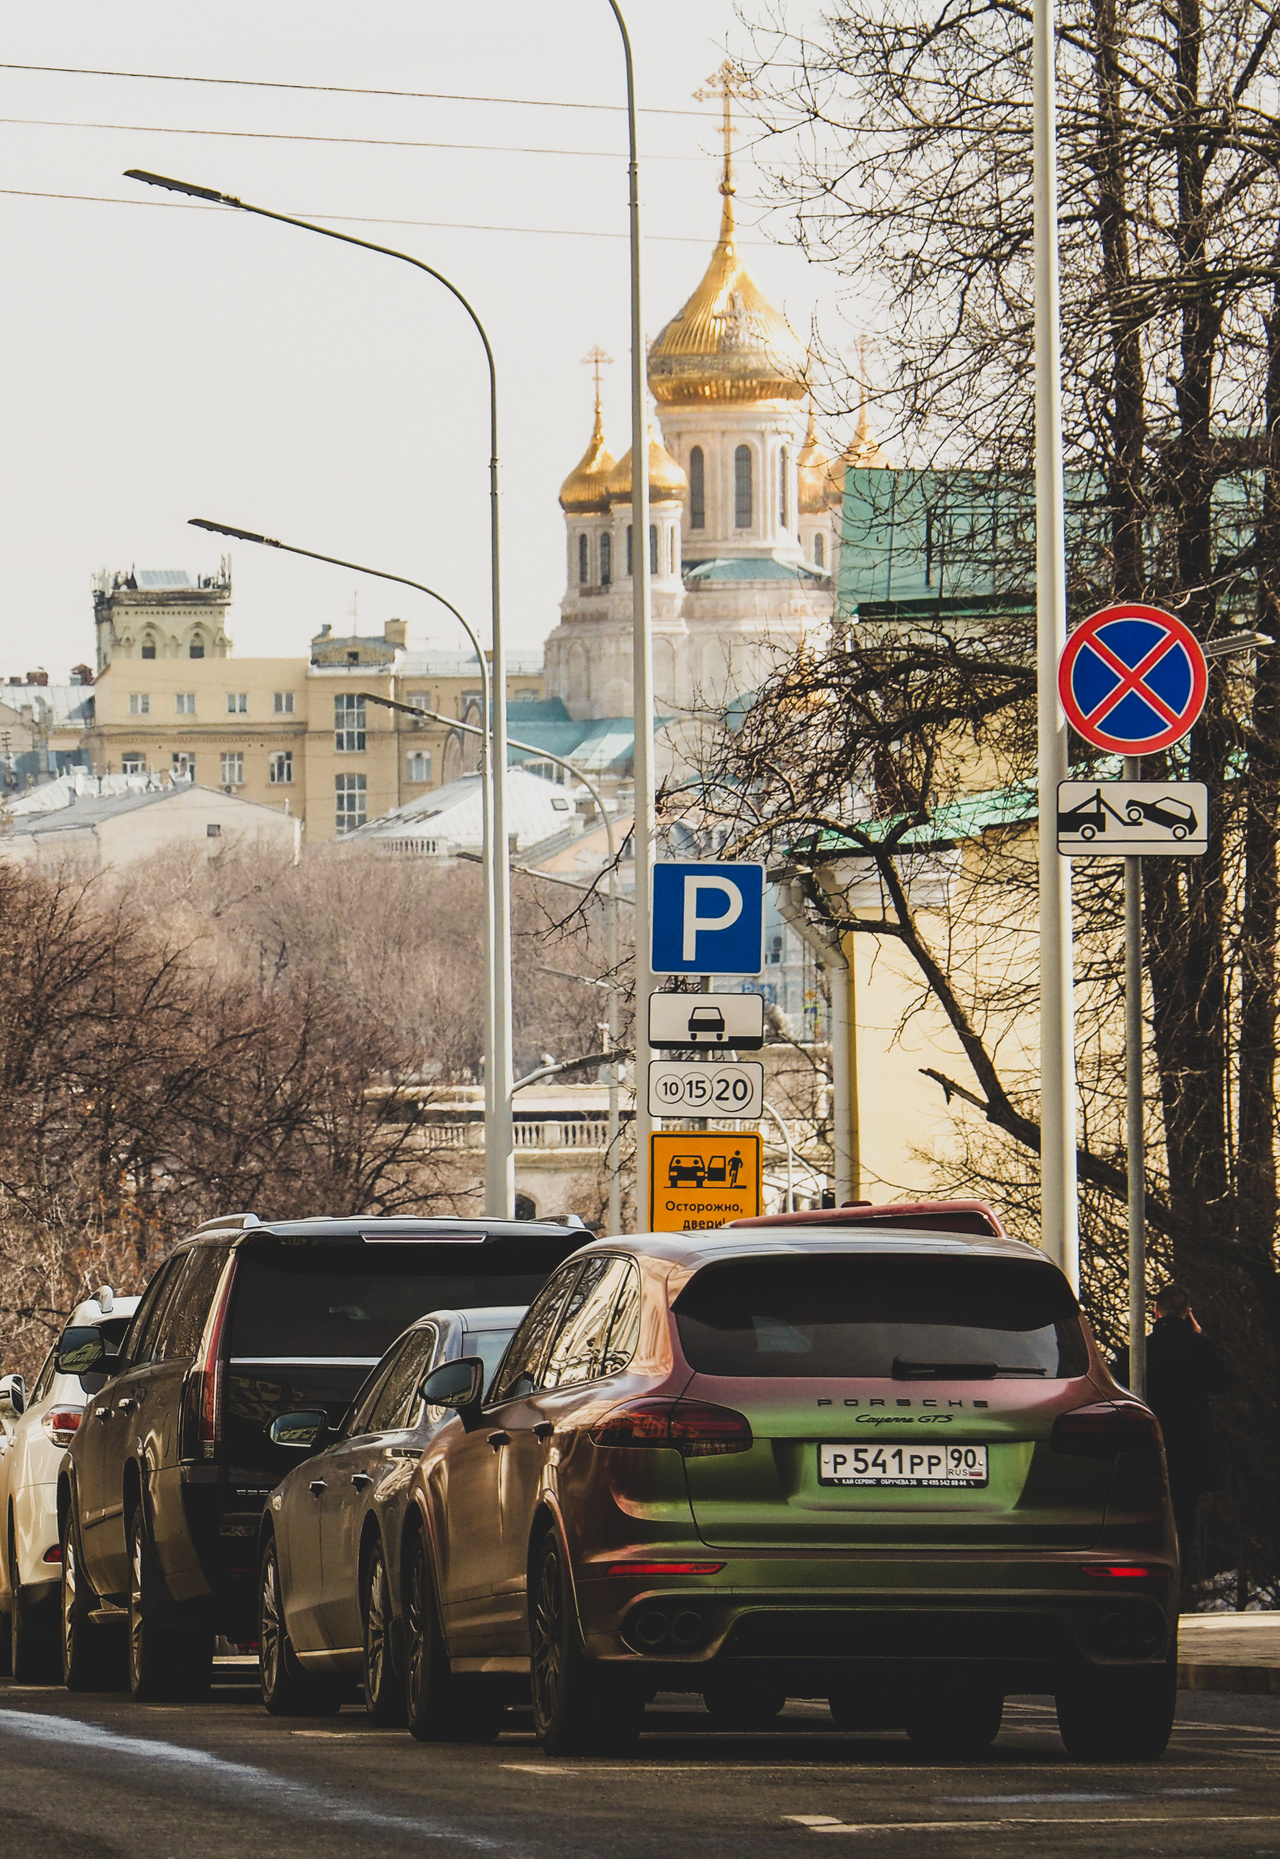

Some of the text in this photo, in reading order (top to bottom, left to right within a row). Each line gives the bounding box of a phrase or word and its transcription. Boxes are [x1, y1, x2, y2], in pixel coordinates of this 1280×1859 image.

[682, 875, 743, 961] P
[662, 1078, 748, 1101] 10 15 20
[665, 1200, 743, 1213] Осторожно,
[817, 1399, 988, 1408] PORSCHE
[855, 1413, 954, 1427] Cayenne GTS
[950, 1448, 976, 1468] 90
